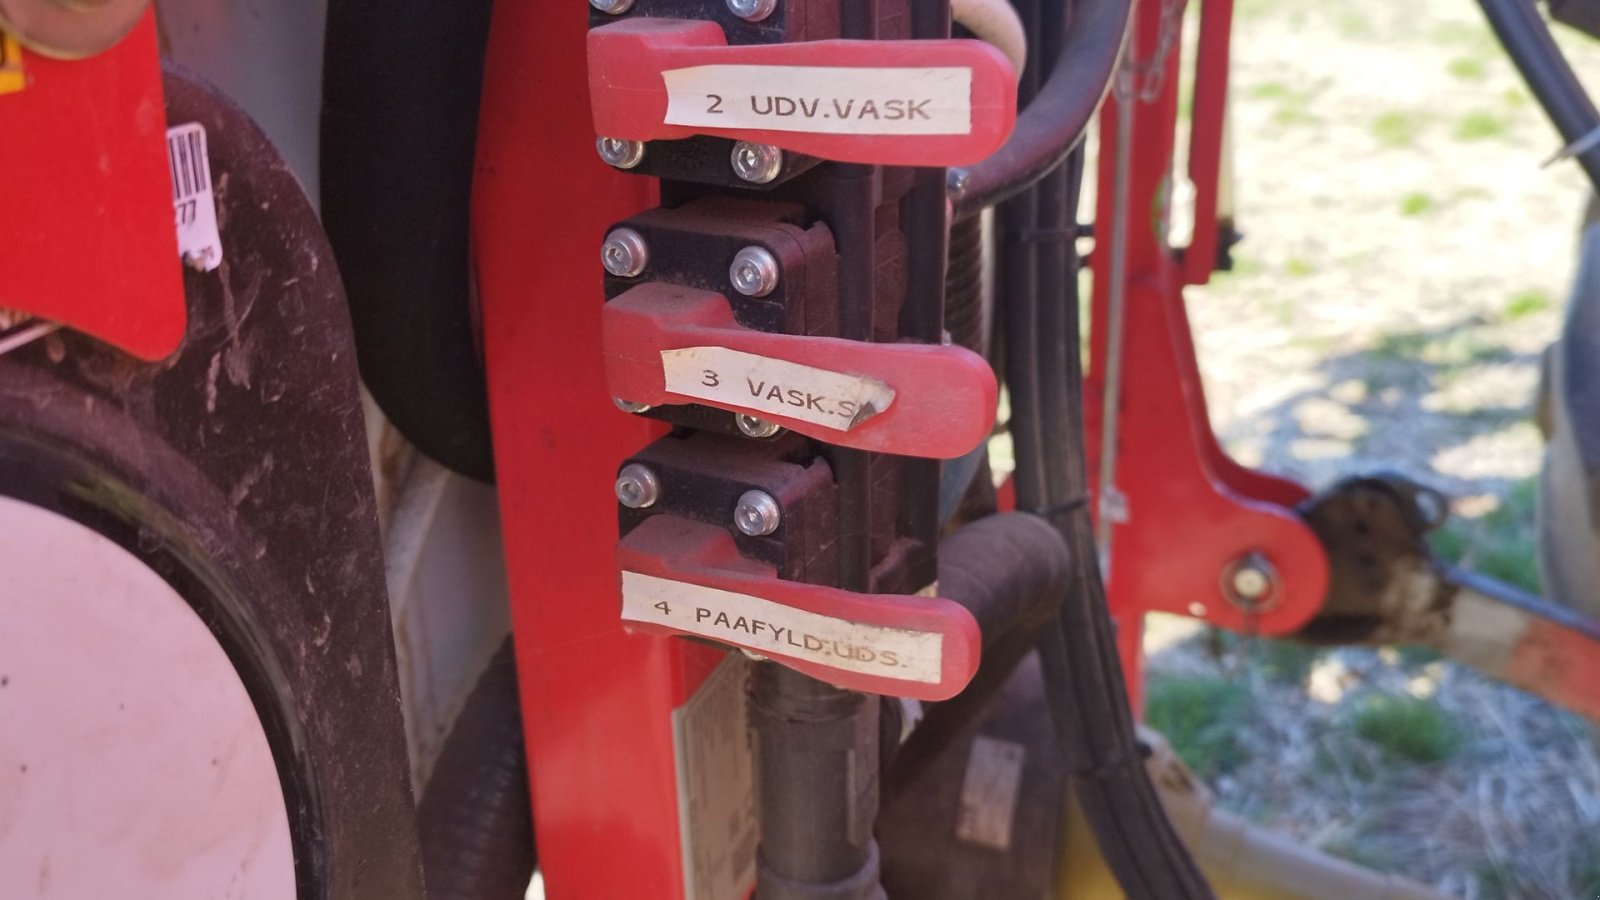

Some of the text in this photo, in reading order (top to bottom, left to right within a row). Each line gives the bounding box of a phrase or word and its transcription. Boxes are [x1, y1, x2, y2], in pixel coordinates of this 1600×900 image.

[706, 94, 932, 120] 2 UDV.VASK
[175, 199, 197, 227] 77
[701, 369, 857, 418] 3 VASK.S
[654, 601, 672, 615] 4
